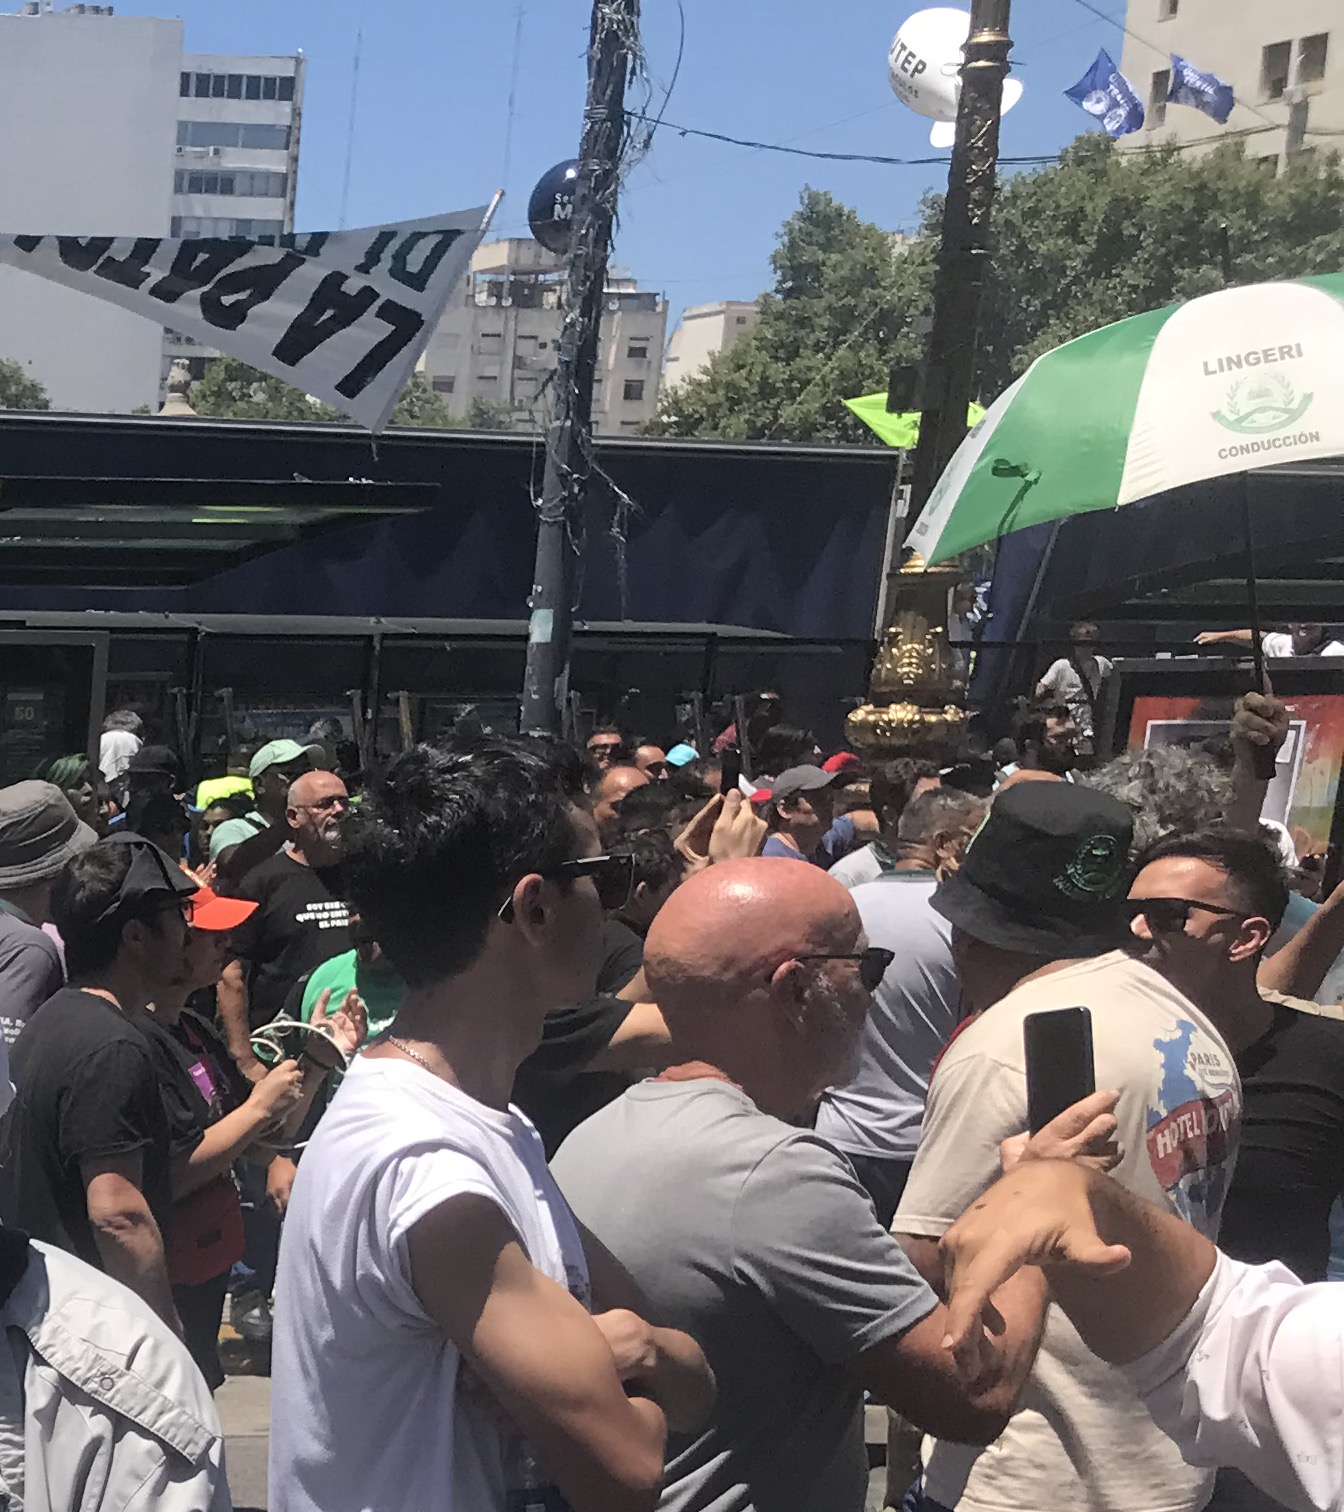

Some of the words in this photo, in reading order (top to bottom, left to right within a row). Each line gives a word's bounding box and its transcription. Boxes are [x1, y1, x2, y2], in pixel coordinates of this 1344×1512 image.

[1202, 342, 1304, 376] LINGERI
[1217, 430, 1321, 460] CONDUCCIÓN
[1190, 1052, 1221, 1067] PARIS
[1156, 1110, 1201, 1159] HOTEL
